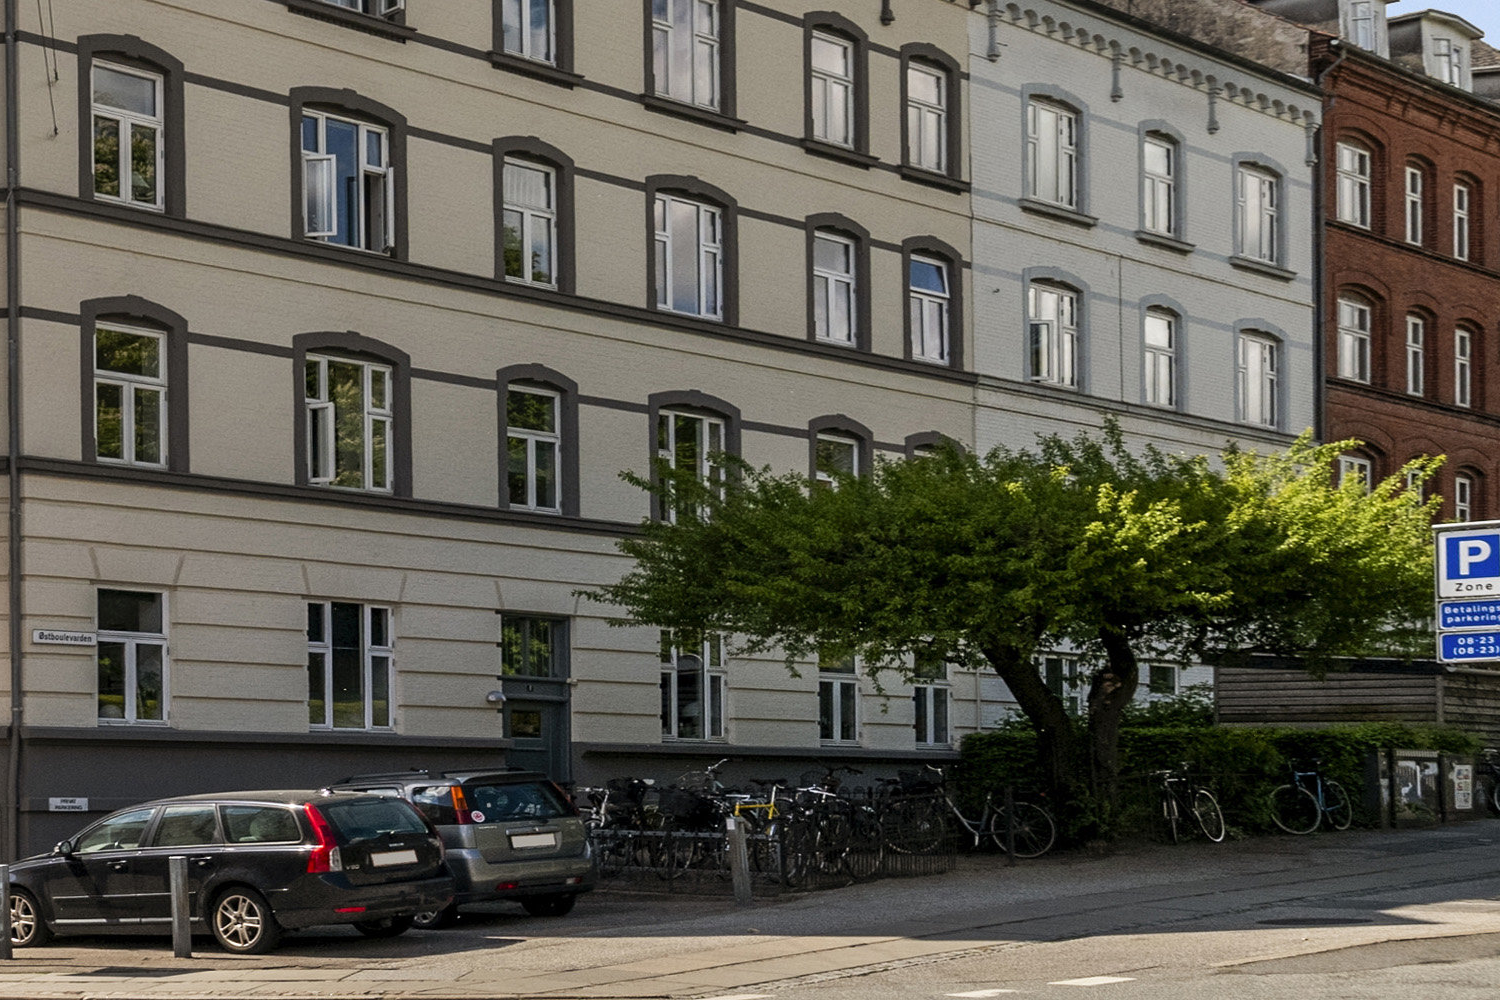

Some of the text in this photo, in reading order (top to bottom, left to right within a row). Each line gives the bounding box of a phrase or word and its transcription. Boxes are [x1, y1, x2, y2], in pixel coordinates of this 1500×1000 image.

[1459, 539, 1491, 575] P
[1455, 582, 1493, 592] Zone
[38, 631, 92, 642] Østboulevarden
[1457, 636, 1495, 645] 08-23
[1453, 645, 1500, 655] (08-23)
